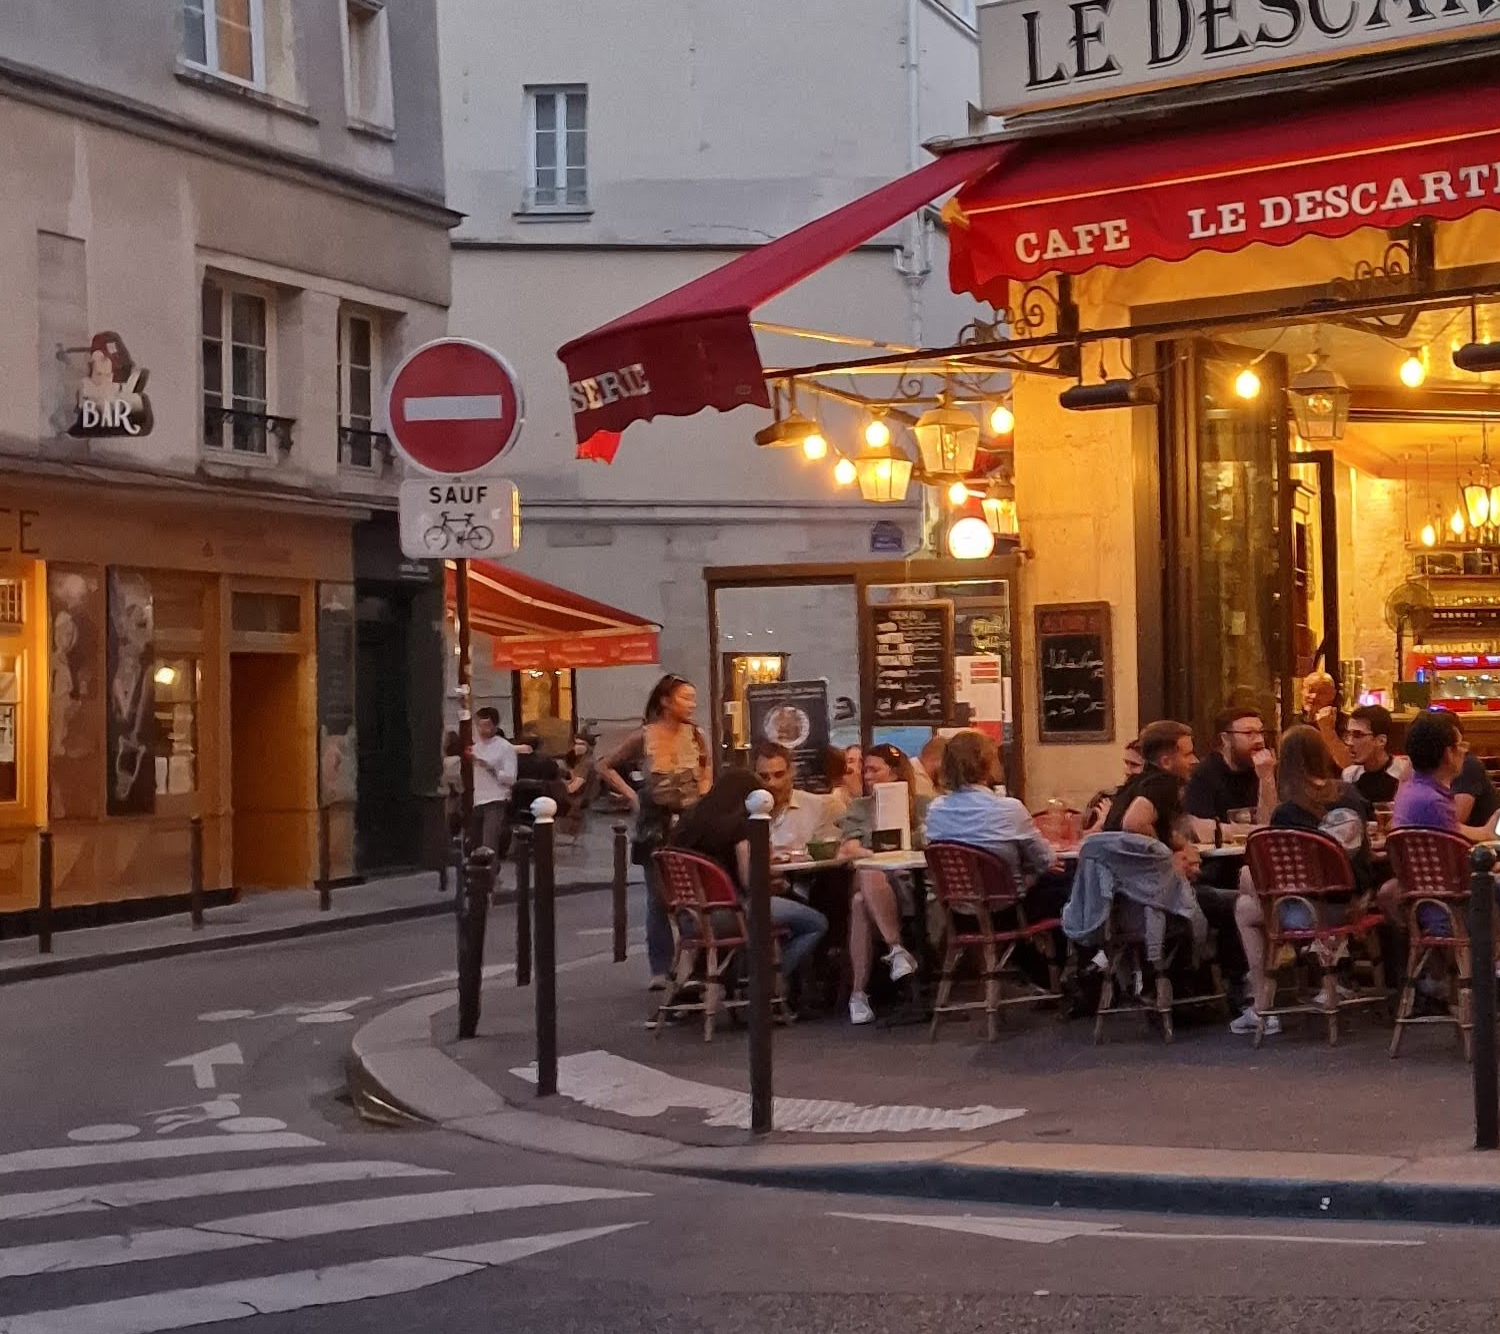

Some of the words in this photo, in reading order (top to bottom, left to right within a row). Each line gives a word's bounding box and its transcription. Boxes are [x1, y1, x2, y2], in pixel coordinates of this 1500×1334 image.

[1014, 218, 1131, 264] CAFE
[1187, 201, 1247, 239] LE
[82, 398, 142, 435] BAR
[428, 485, 488, 504] SAUF
